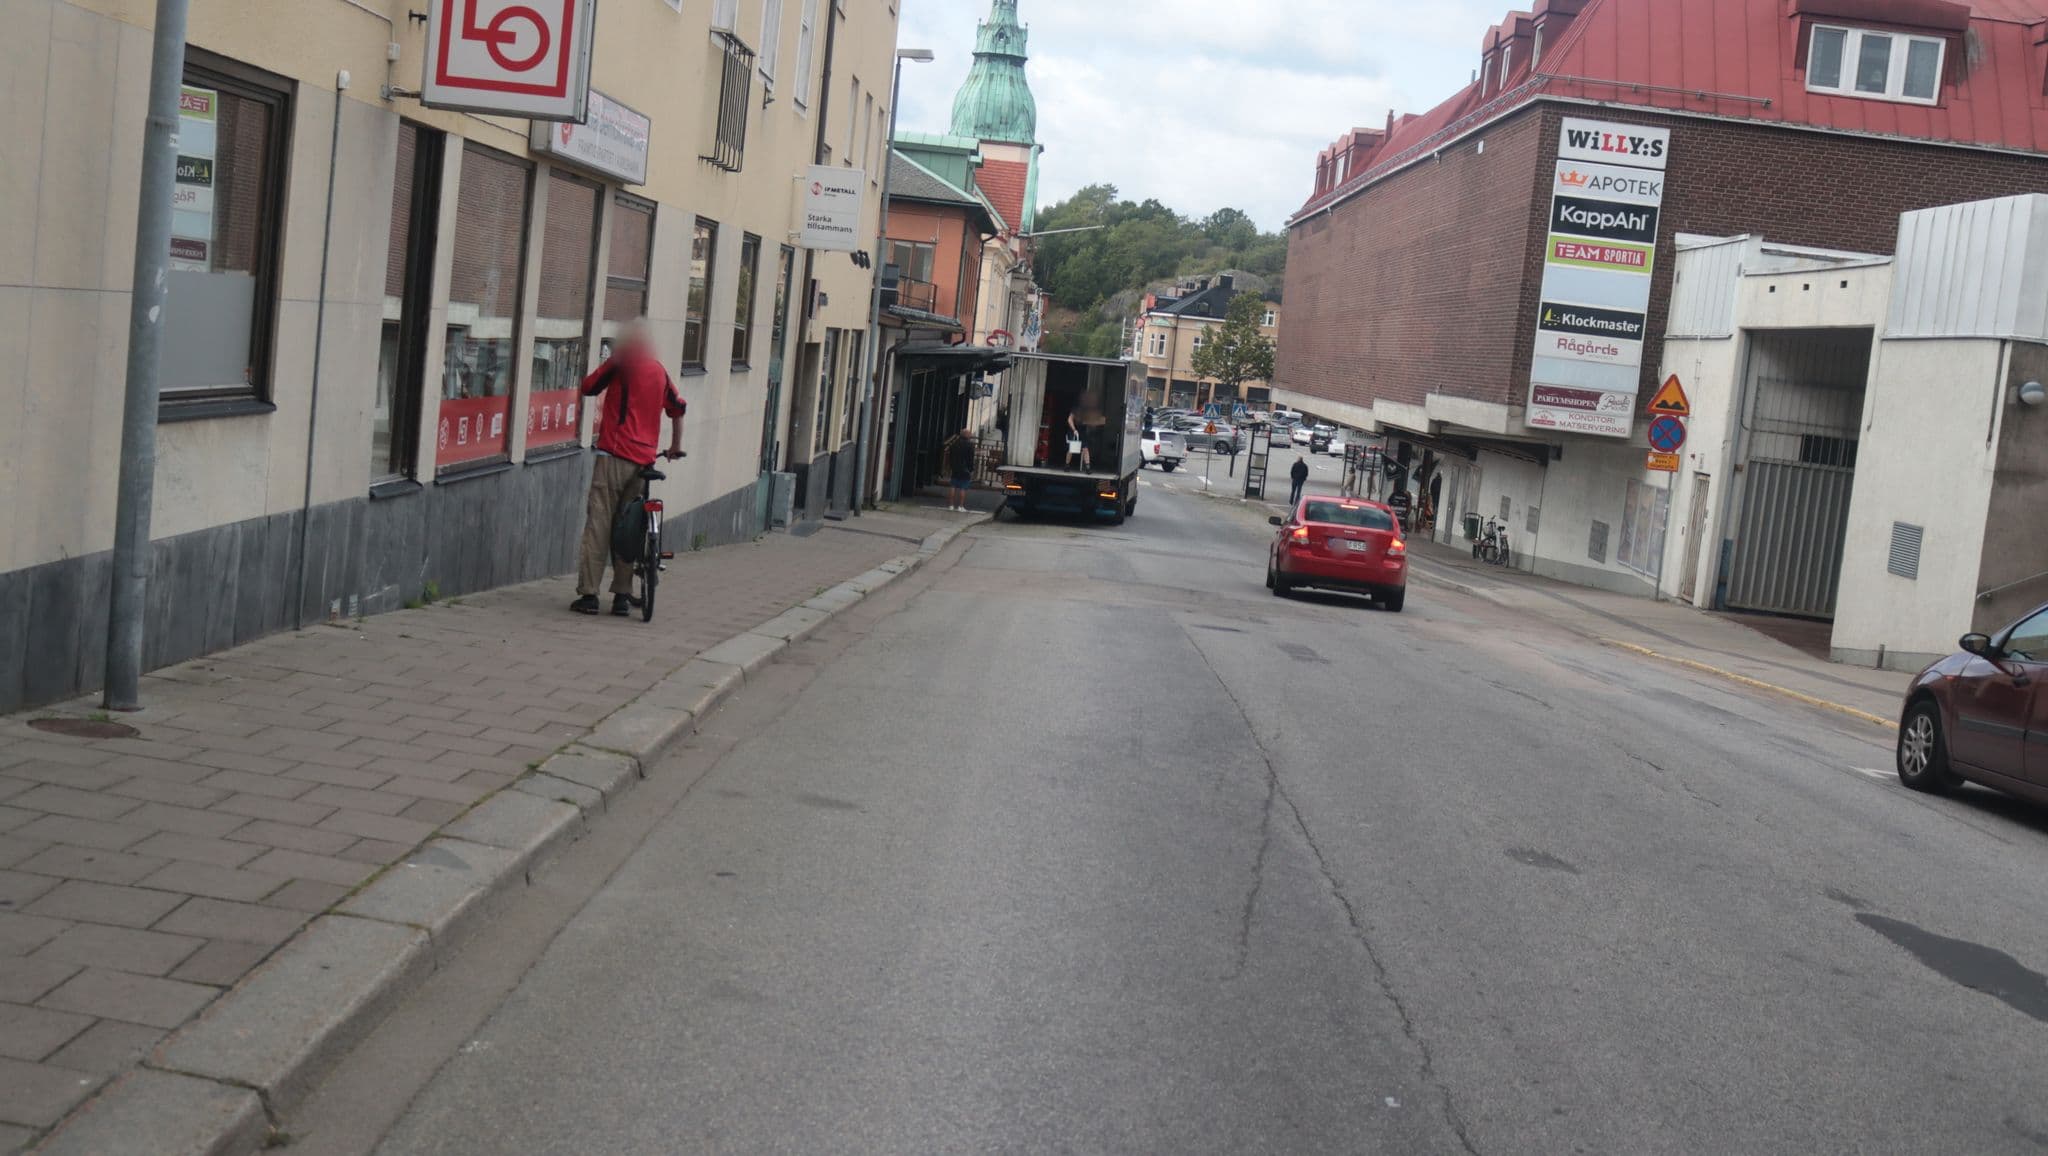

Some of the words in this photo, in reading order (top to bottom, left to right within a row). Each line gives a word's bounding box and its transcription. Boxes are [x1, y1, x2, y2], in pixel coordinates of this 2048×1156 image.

[1588, 176, 1661, 196] APOTEK
[807, 214, 832, 223] Starka
[1560, 204, 1646, 231] KappAhl
[807, 223, 853, 233] tillsammans
[1557, 243, 1601, 260] TEAM
[1603, 248, 1642, 265] SPORTIA
[1561, 313, 1641, 333] Klockmaster
[1556, 337, 1619, 356] Rågårds
[1536, 393, 1598, 408] PARFYMSHOPEN
[1568, 412, 1616, 424] KONDITORI
[1559, 421, 1627, 434] MATSERVERING
